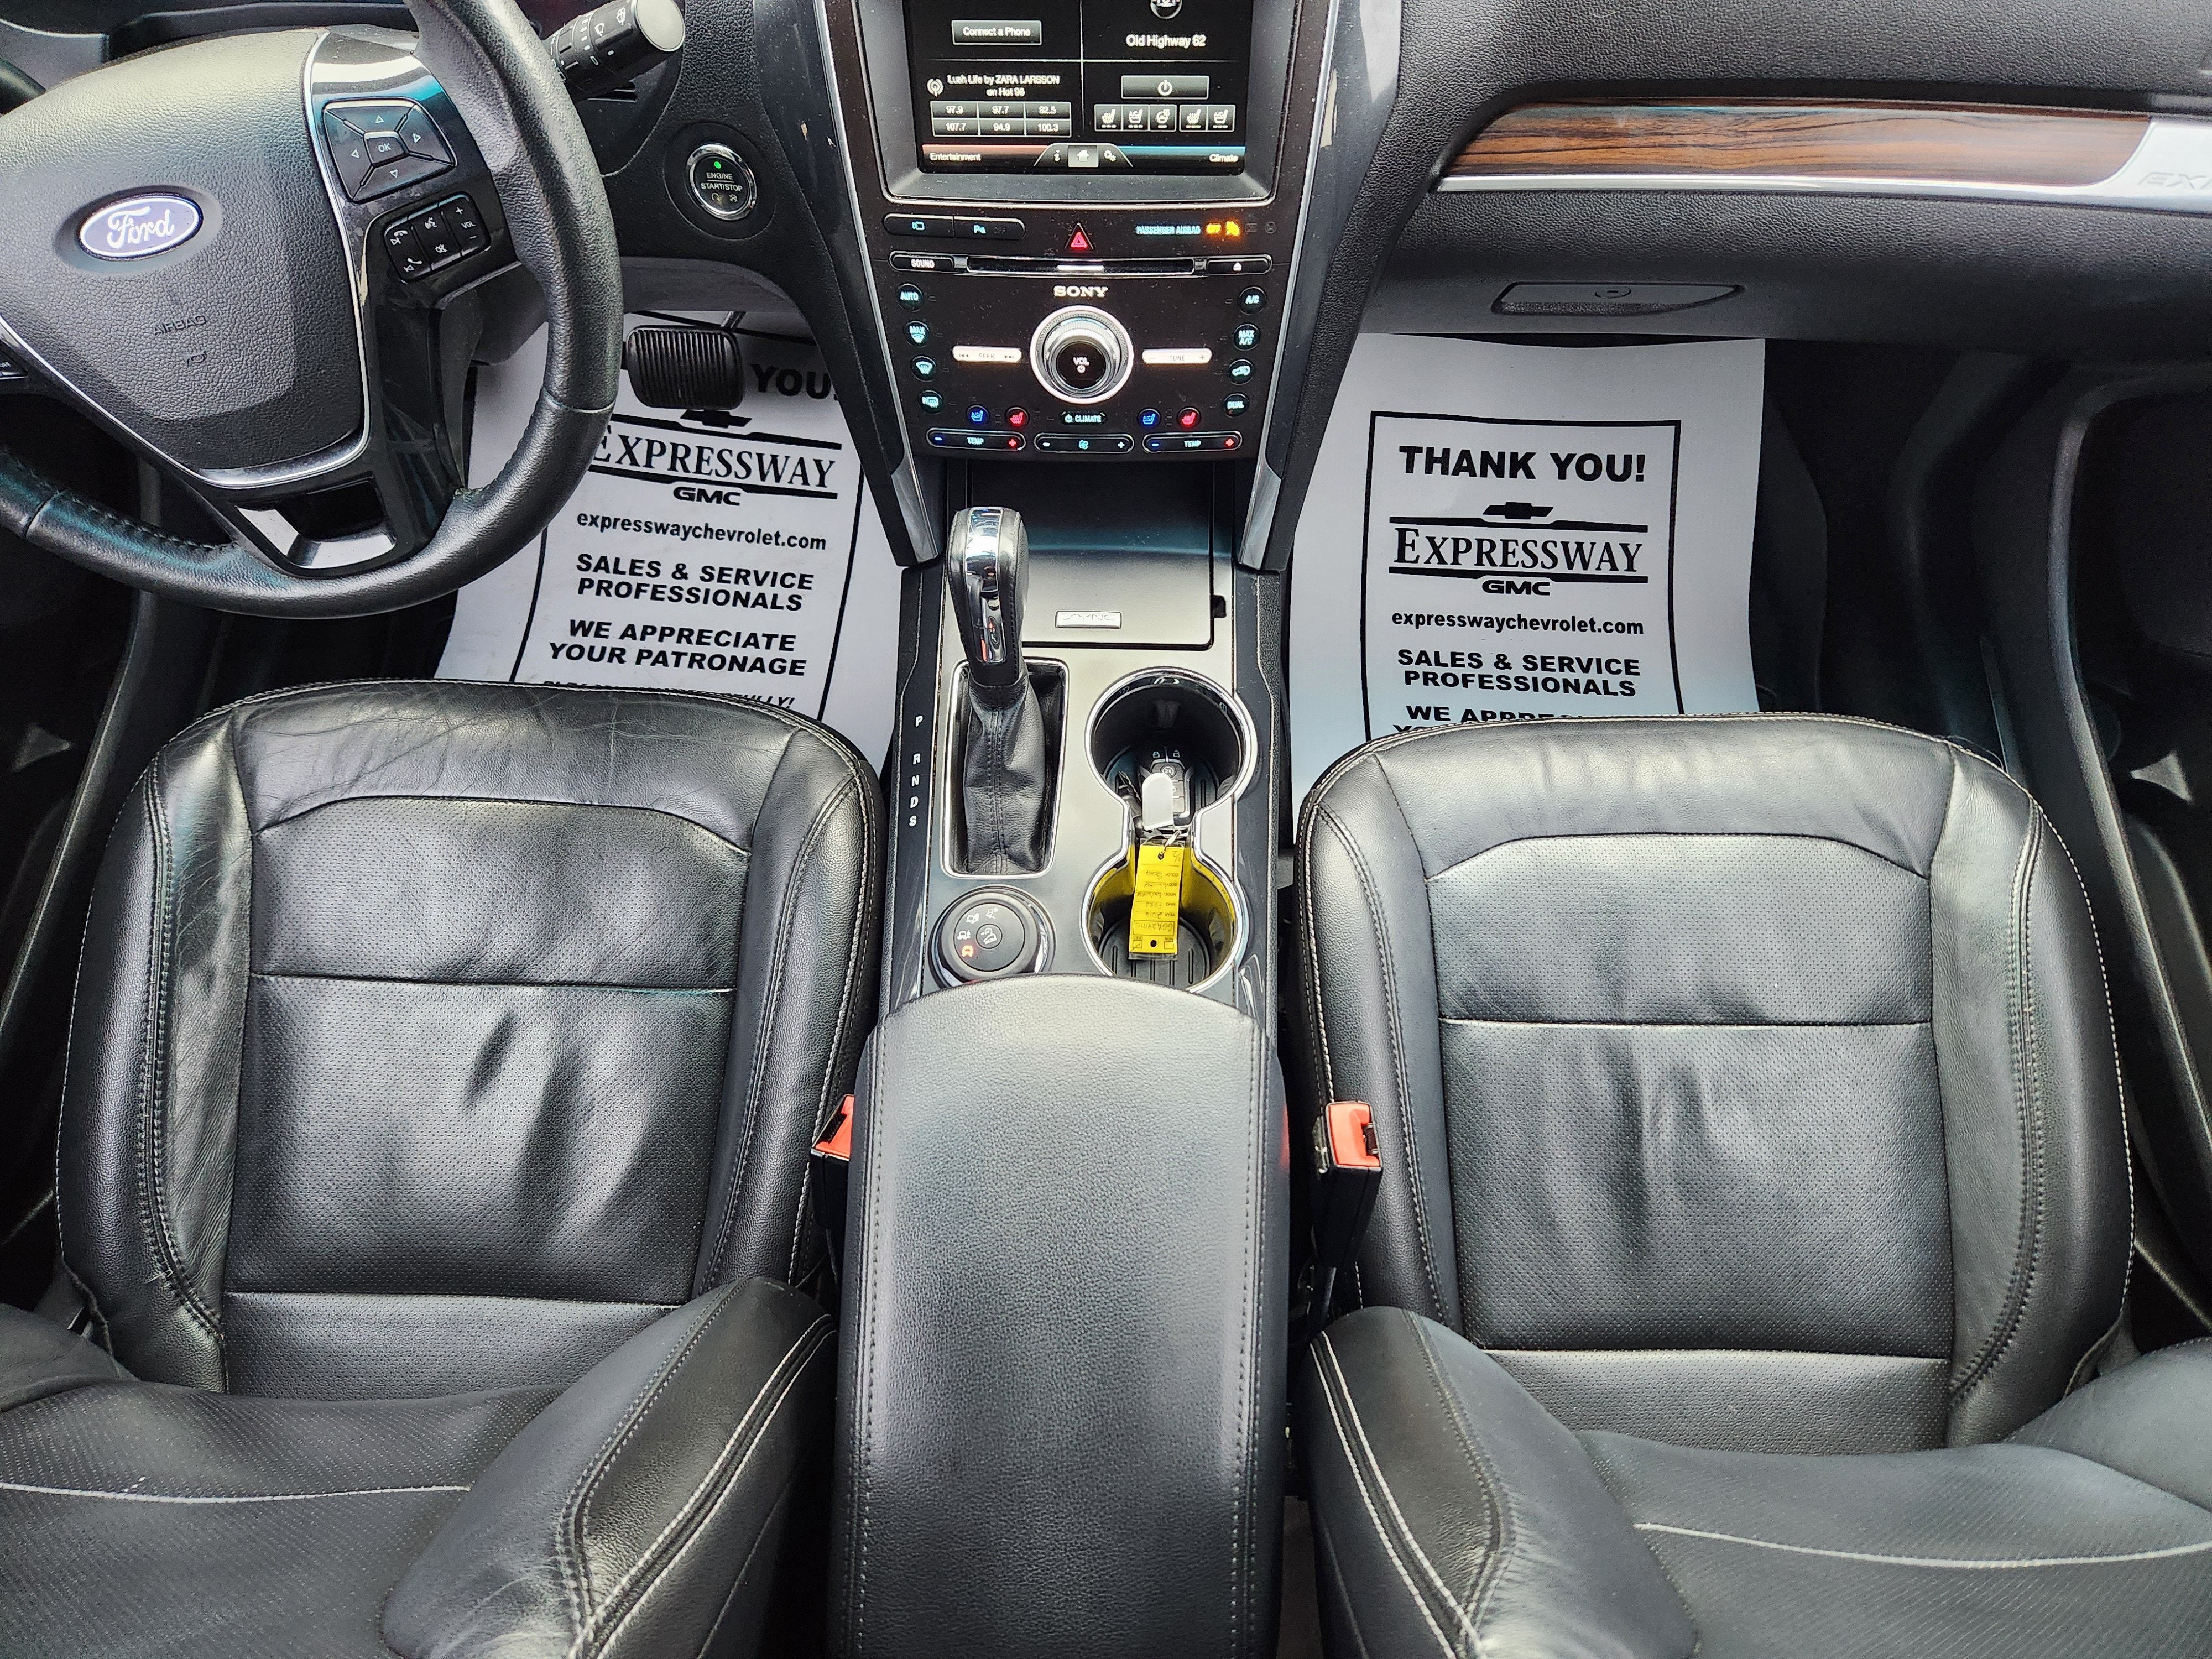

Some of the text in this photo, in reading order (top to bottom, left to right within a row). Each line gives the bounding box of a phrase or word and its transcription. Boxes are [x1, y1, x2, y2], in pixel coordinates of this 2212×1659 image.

[963, 27, 1031, 37] Connect a Phone
[1126, 34, 1207, 49] Old Highway 62
[947, 75, 1060, 86] Lush Life by ZARA LARSSON
[986, 88, 998, 97] on
[999, 87, 1014, 97] Hot
[946, 106, 963, 114] 97.9
[992, 106, 1009, 115] 97.7
[1039, 106, 1056, 115] 92.5
[945, 122, 966, 132] 107.7
[993, 123, 1010, 132] 94.9
[1037, 123, 1059, 132] 100.3
[378, 143, 392, 153] OK
[930, 152, 982, 161] Entertainment
[1209, 153, 1239, 163] Climate
[700, 182, 743, 192] START/STOP
[107, 206, 175, 249] Ford
[461, 220, 477, 228] VOL
[1136, 225, 1201, 234] PASSENGER AIRBAG
[911, 259, 935, 268] SOUND
[900, 291, 919, 301] AUTO
[1053, 285, 1108, 298] SONY
[1245, 295, 1260, 304] A/C
[153, 316, 207, 335] AIRBAG
[909, 326, 926, 335] MAX
[1238, 329, 1255, 338] MAX
[1239, 337, 1253, 345] A/C
[1073, 357, 1090, 366] VOL
[751, 363, 838, 401] YOU
[1227, 401, 1245, 409] DUAL
[1074, 415, 1102, 423] CLIMATE
[966, 437, 984, 445] TEMP
[1399, 445, 1646, 482] THANK YOU!
[673, 486, 741, 506] GMC
[577, 512, 826, 550] expresswaychevrolet.com
[576, 554, 815, 591] SALES & SERVICE
[1481, 580, 1550, 596] GMC
[577, 578, 802, 611] PROFESSIONALS
[1392, 612, 1644, 635] expresswaychevrolet.com
[569, 619, 796, 651] WE APPRECIATE
[550, 643, 807, 676] YOUR PATRONAGE
[1397, 649, 1641, 676] SALES & SERVICE
[1404, 670, 1636, 697] PROFESSIONALS
[1406, 705, 1451, 722] WE
[915, 715, 923, 727] P
[912, 753, 921, 765] R
[911, 774, 920, 787] N
[910, 796, 919, 808] D
[909, 815, 917, 827] S
